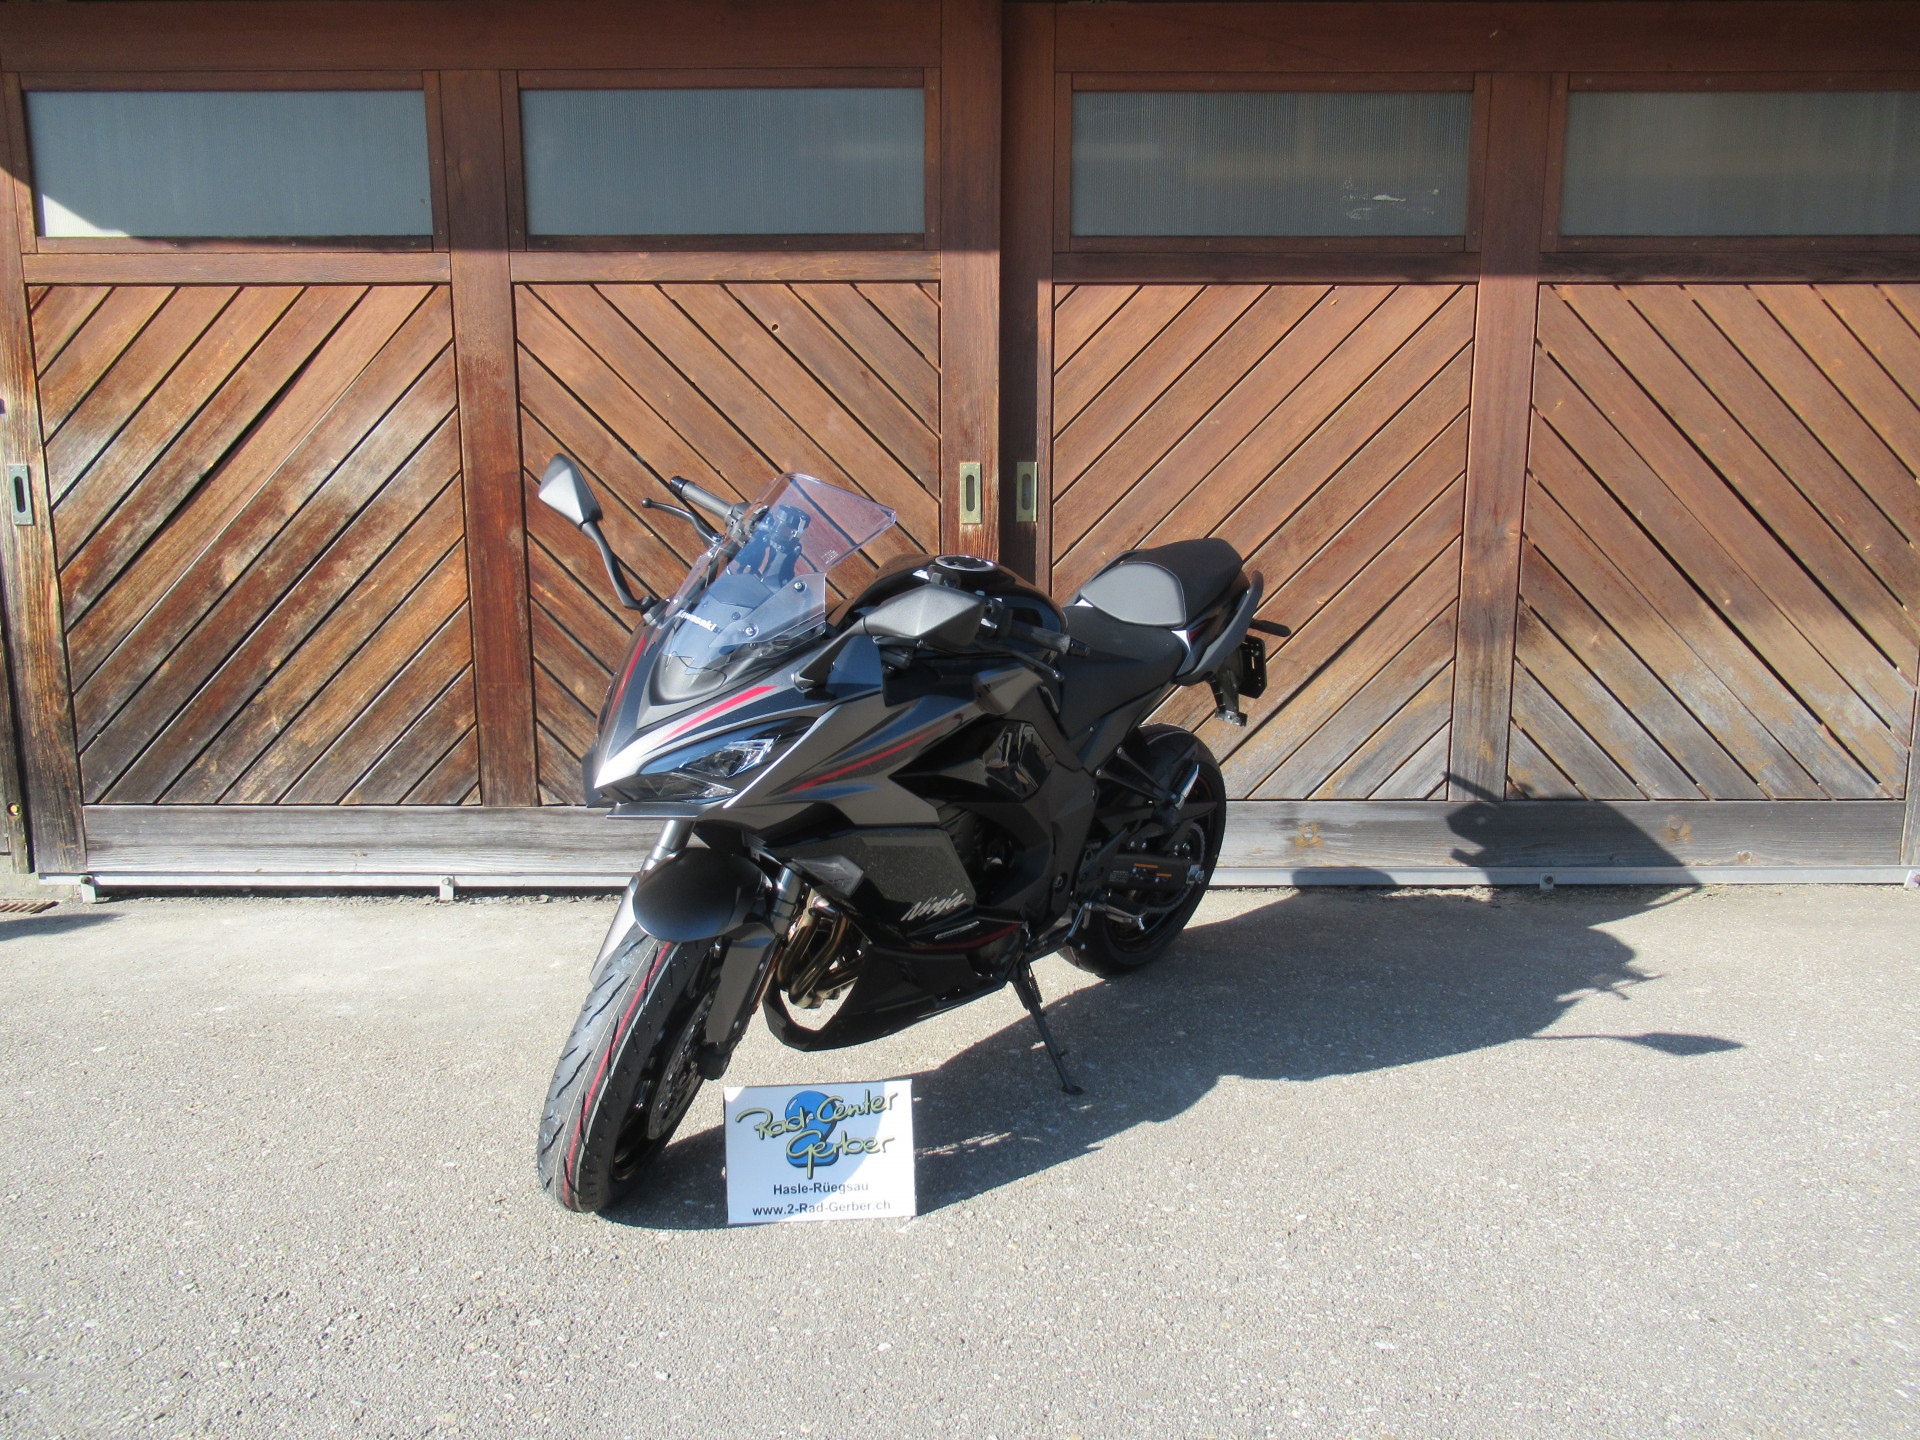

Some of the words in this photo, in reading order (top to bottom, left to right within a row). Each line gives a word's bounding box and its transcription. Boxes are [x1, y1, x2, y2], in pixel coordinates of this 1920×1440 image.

[675, 609, 717, 631] Kawasaki
[900, 889, 967, 921] Ninja
[786, 1131, 895, 1180] Gerber
[773, 1182, 869, 1195] Hasle-Rüegsau
[752, 1200, 891, 1215] www.2-Rad-Gerber.ch
